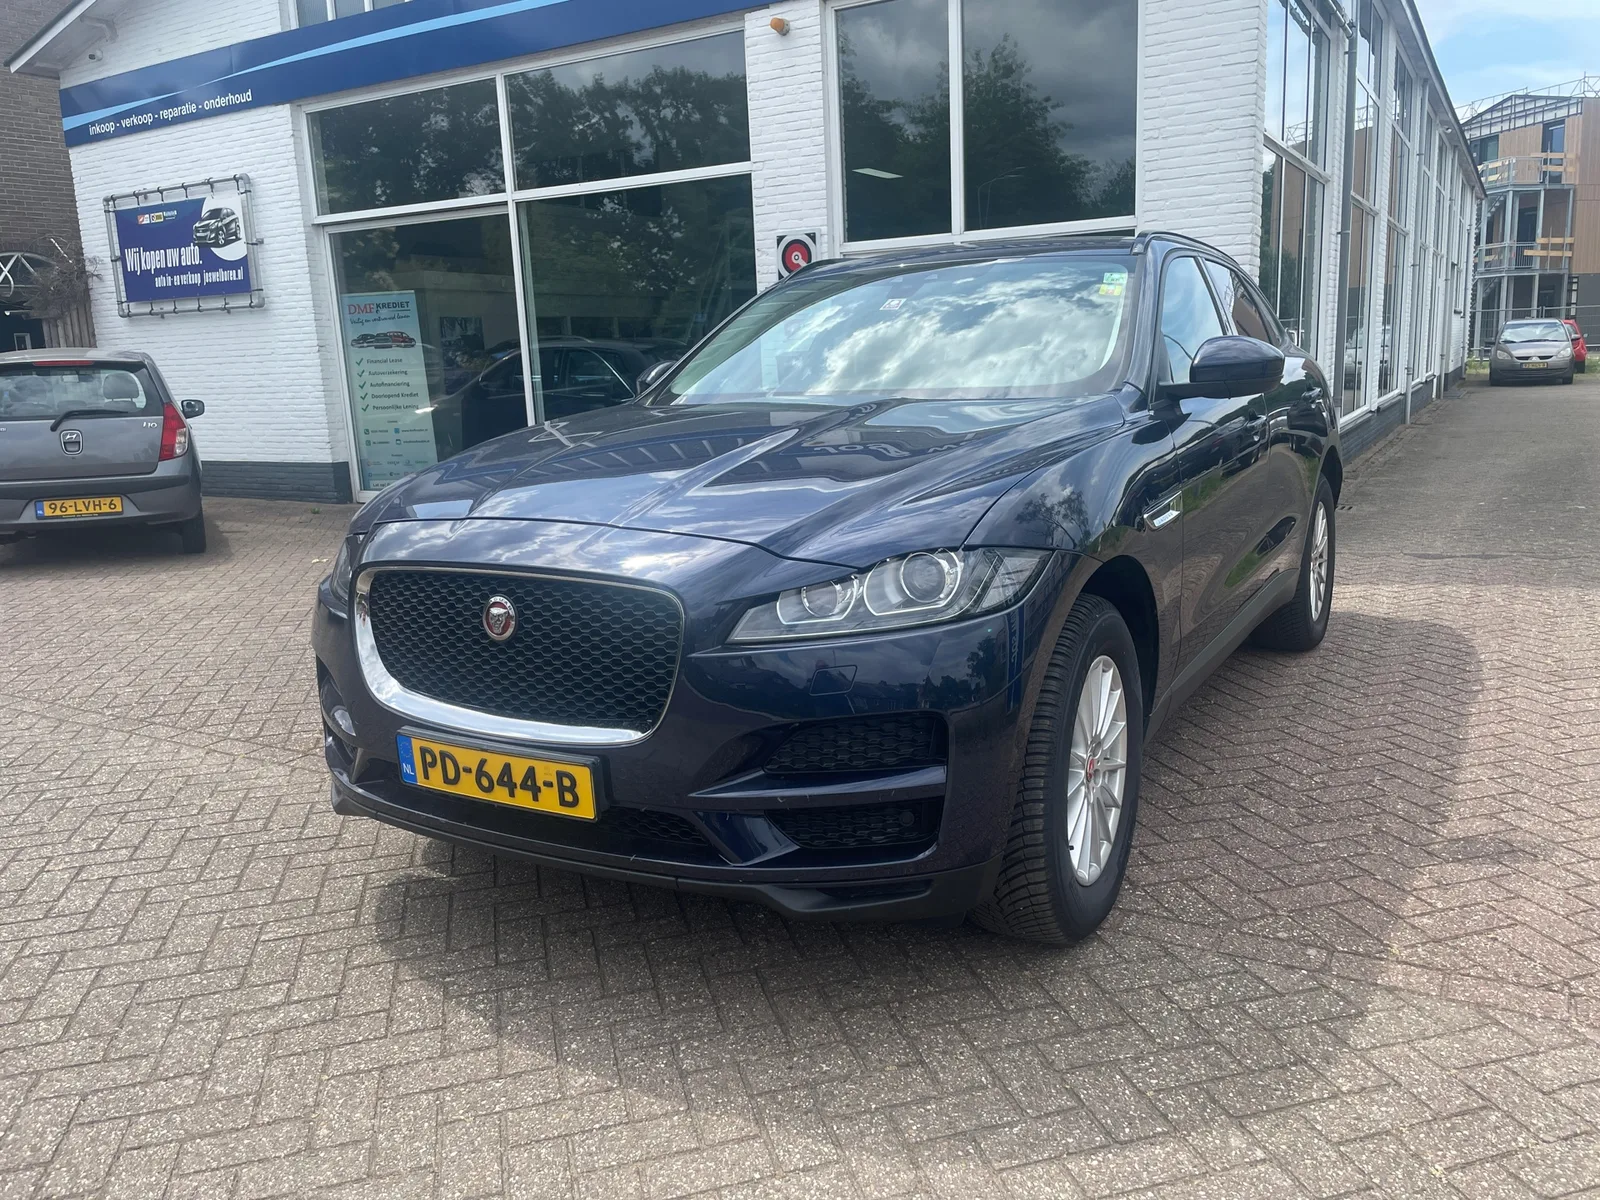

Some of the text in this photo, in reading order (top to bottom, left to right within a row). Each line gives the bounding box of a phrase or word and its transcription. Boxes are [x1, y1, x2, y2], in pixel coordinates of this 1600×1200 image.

[89, 122, 115, 136] inkoop
[120, 113, 153, 128] verkoop
[159, 103, 197, 121] reparatie
[204, 89, 252, 110] onderhoud
[125, 242, 203, 275] Wij kopen uw auto.
[155, 274, 166, 288] auto
[180, 272, 201, 286] verkoop
[376, 301, 410, 310] KREDIET
[48, 498, 117, 514] 96-LVH-6
[402, 762, 415, 776] NL
[419, 745, 580, 808] PD-644-B
